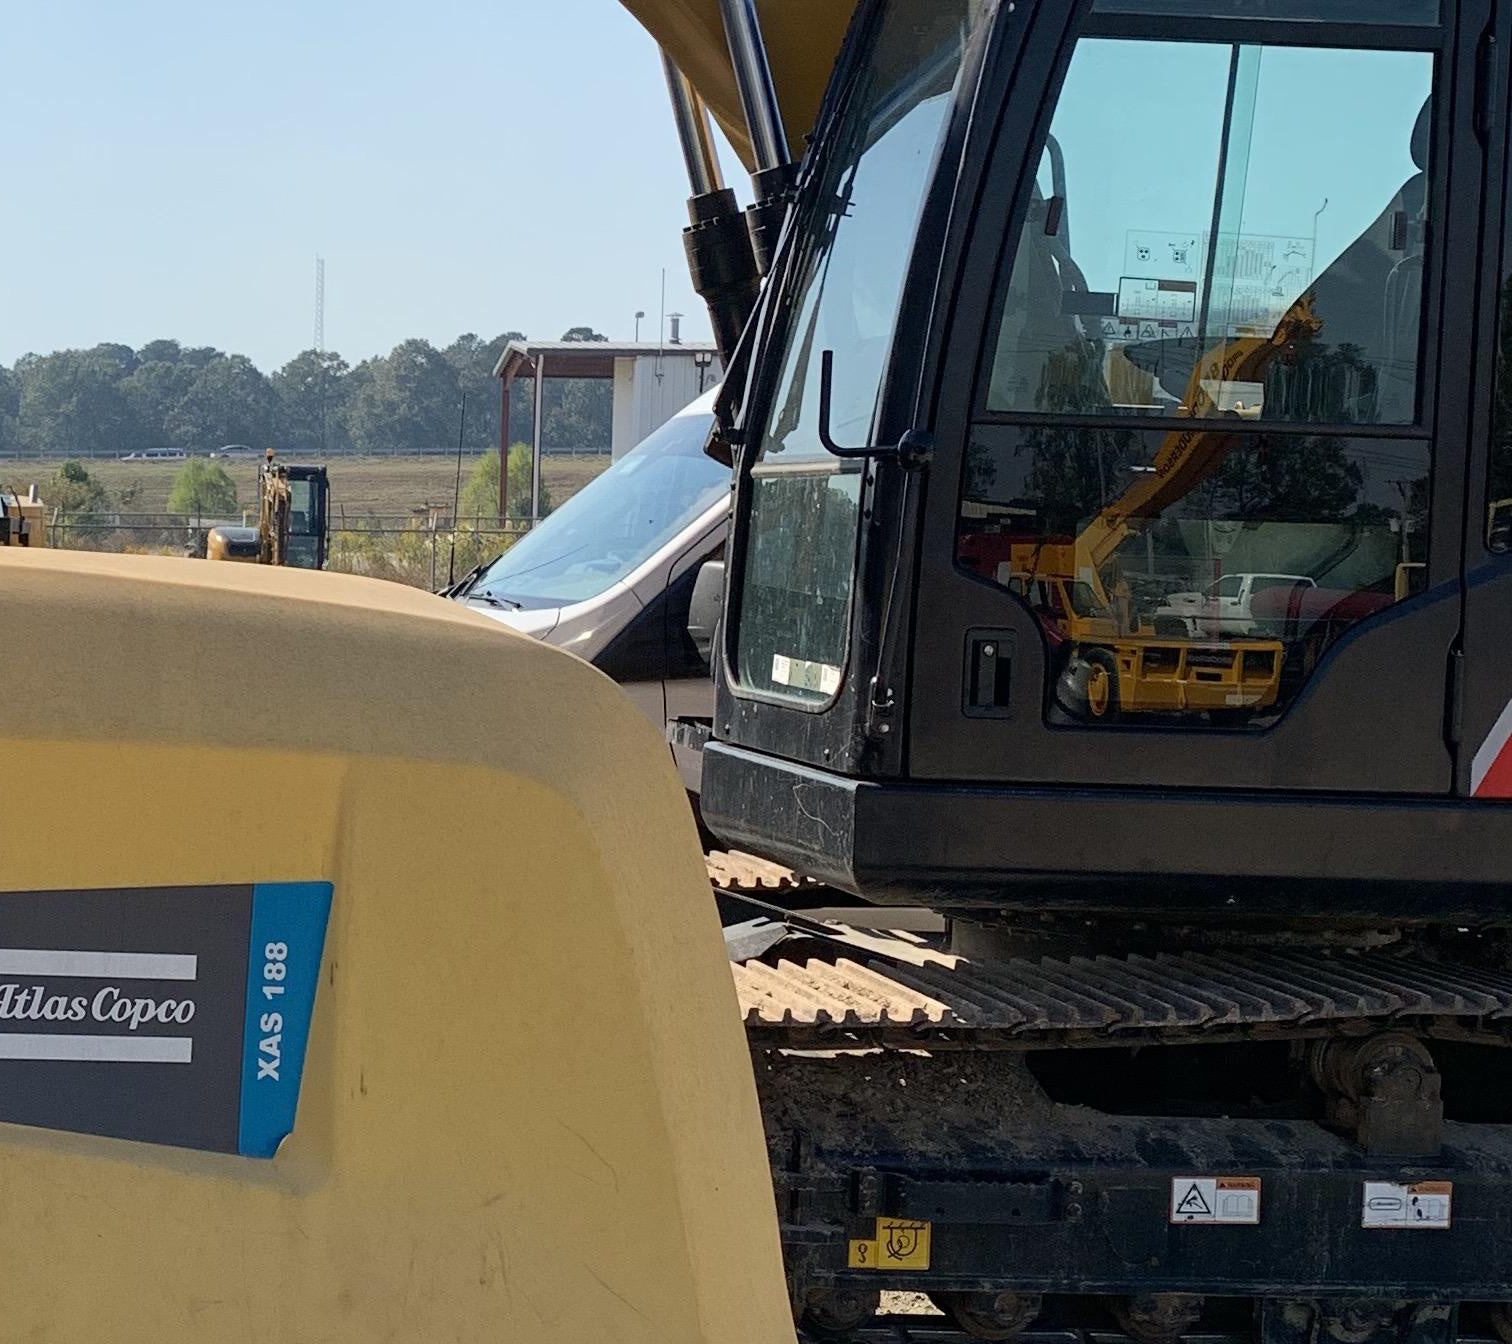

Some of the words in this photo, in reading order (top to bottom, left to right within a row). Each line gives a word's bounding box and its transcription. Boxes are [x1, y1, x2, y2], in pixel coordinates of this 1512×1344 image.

[261, 941, 289, 1000] 188
[90, 986, 196, 1030] Copco
[256, 1012, 285, 1082] XAS
